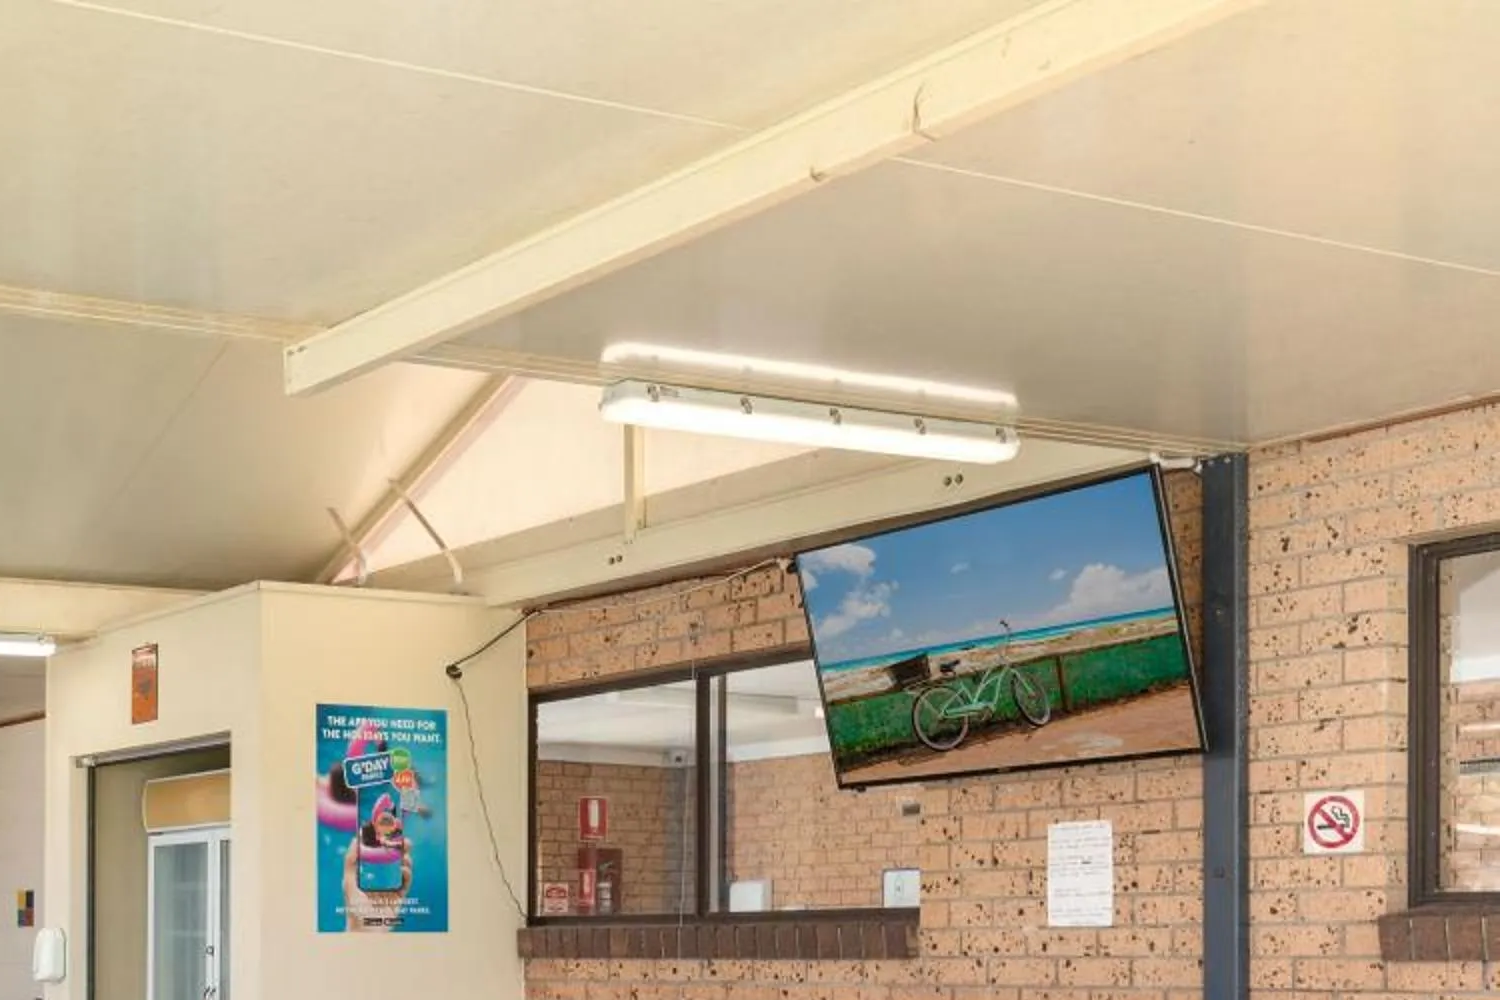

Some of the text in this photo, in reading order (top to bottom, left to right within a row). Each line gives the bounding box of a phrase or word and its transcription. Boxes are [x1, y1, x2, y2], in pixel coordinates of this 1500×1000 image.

[327, 715, 347, 727] THE
[369, 718, 388, 728] YOU
[390, 719, 415, 729] NEED
[417, 720, 437, 731] FOR
[322, 728, 341, 739] THE
[391, 731, 411, 742] YOU
[351, 757, 389, 775] G'DAY
